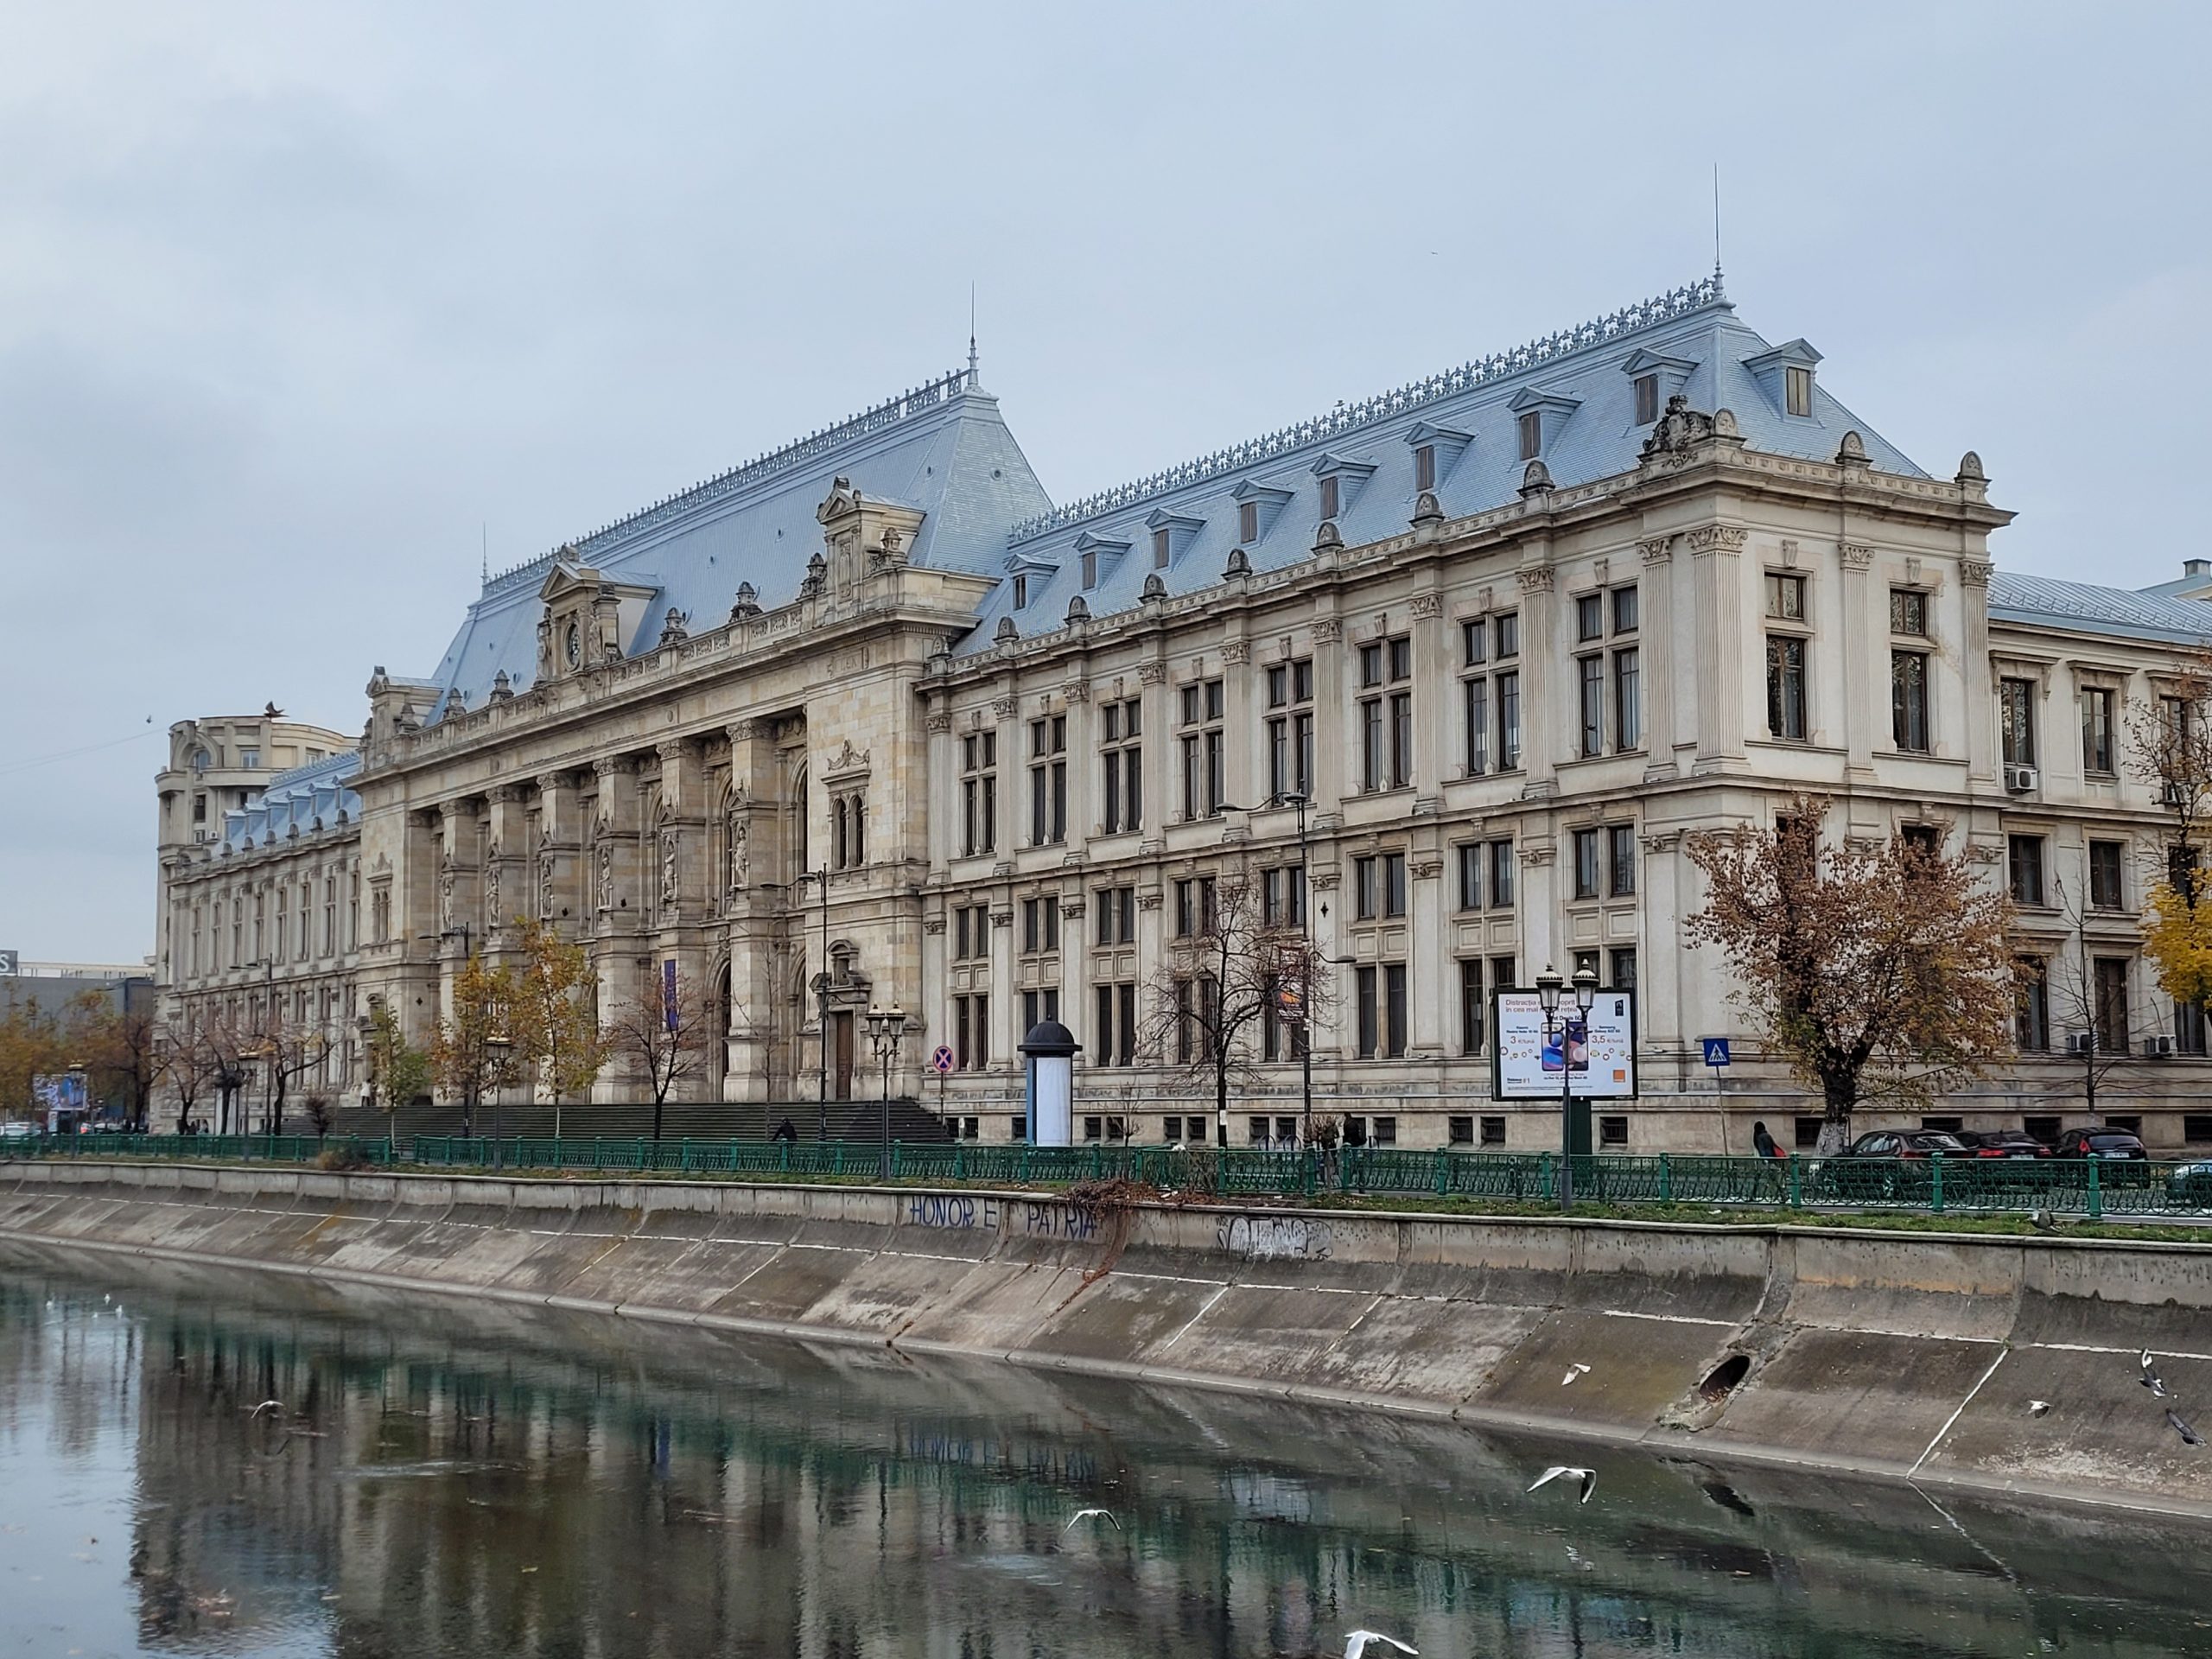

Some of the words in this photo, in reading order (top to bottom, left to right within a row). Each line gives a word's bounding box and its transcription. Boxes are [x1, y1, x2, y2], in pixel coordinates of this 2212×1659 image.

[1592, 1035, 1605, 1044] 3,5
[910, 1196, 975, 1227] HONOR
[1027, 1202, 1096, 1239] PATRIA
